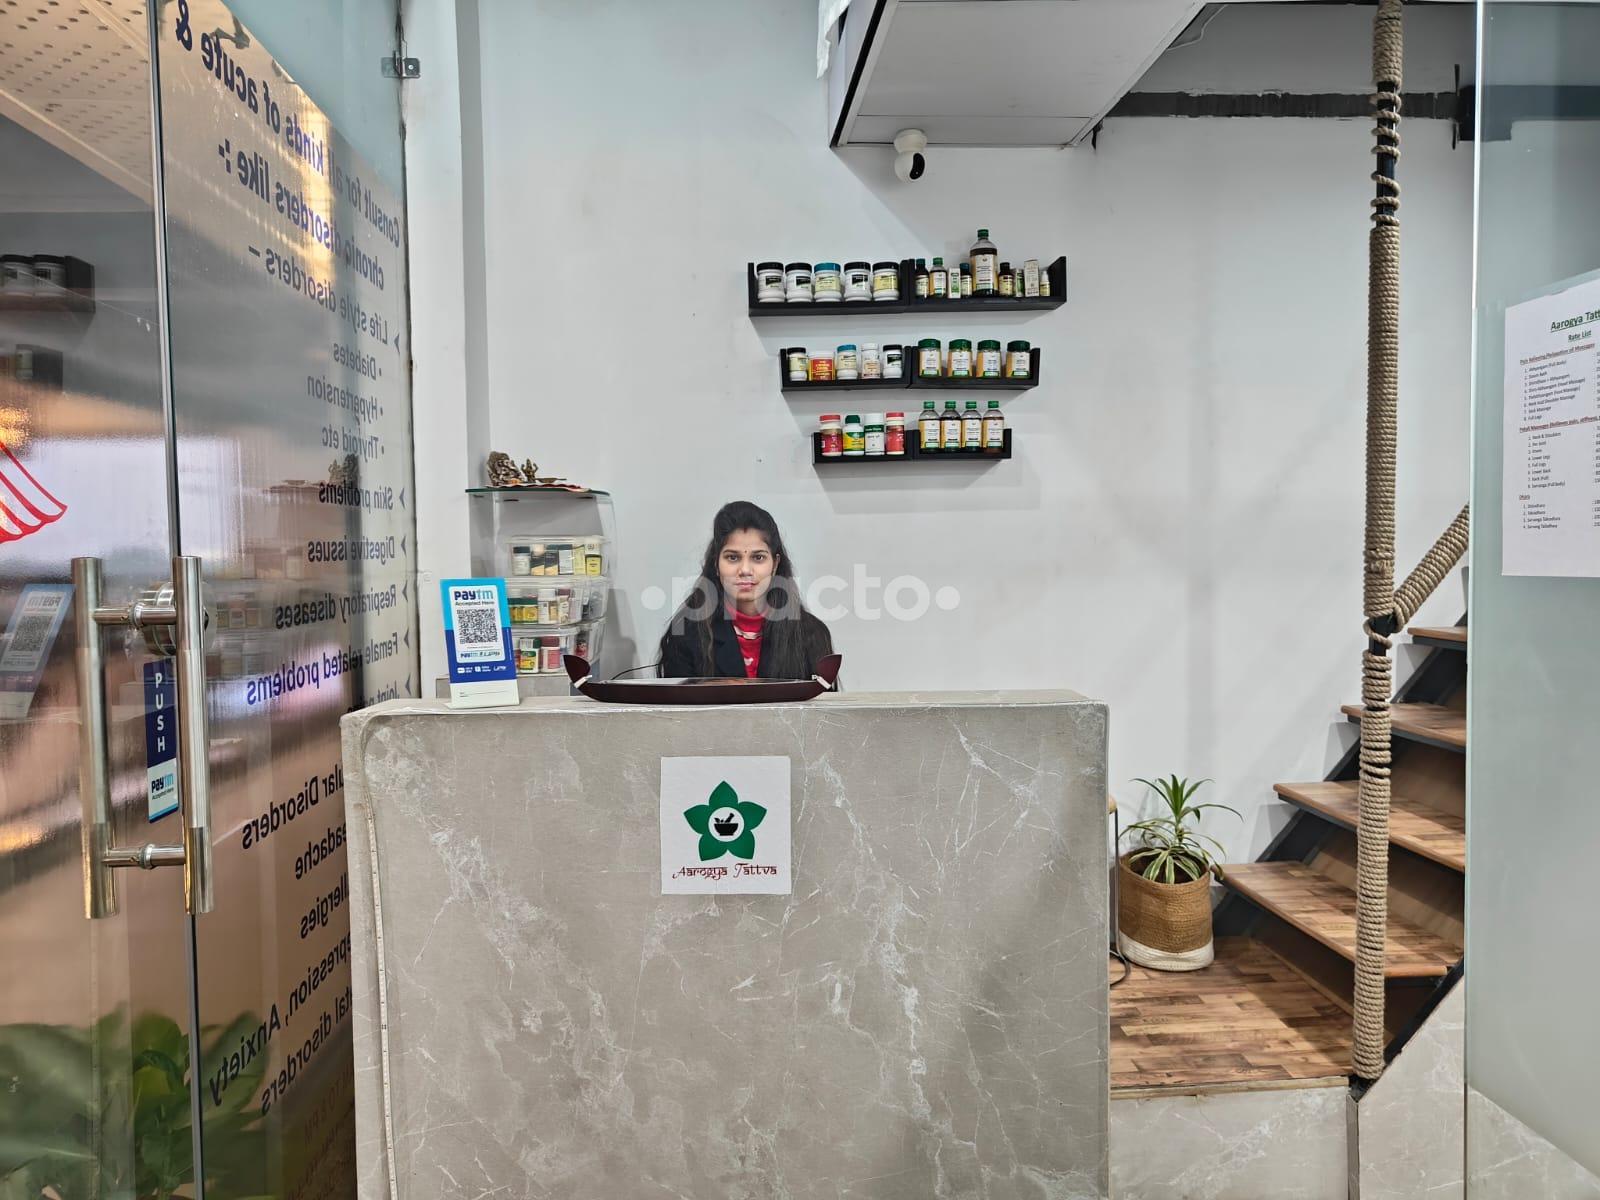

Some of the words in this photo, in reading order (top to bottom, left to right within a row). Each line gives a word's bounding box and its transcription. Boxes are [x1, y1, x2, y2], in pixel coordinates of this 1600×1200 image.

[1551, 315, 1583, 331] Aarogya
[155, 672, 166, 753] PUSH
[672, 865, 728, 880] Aarogya
[733, 863, 778, 878] Tattva
